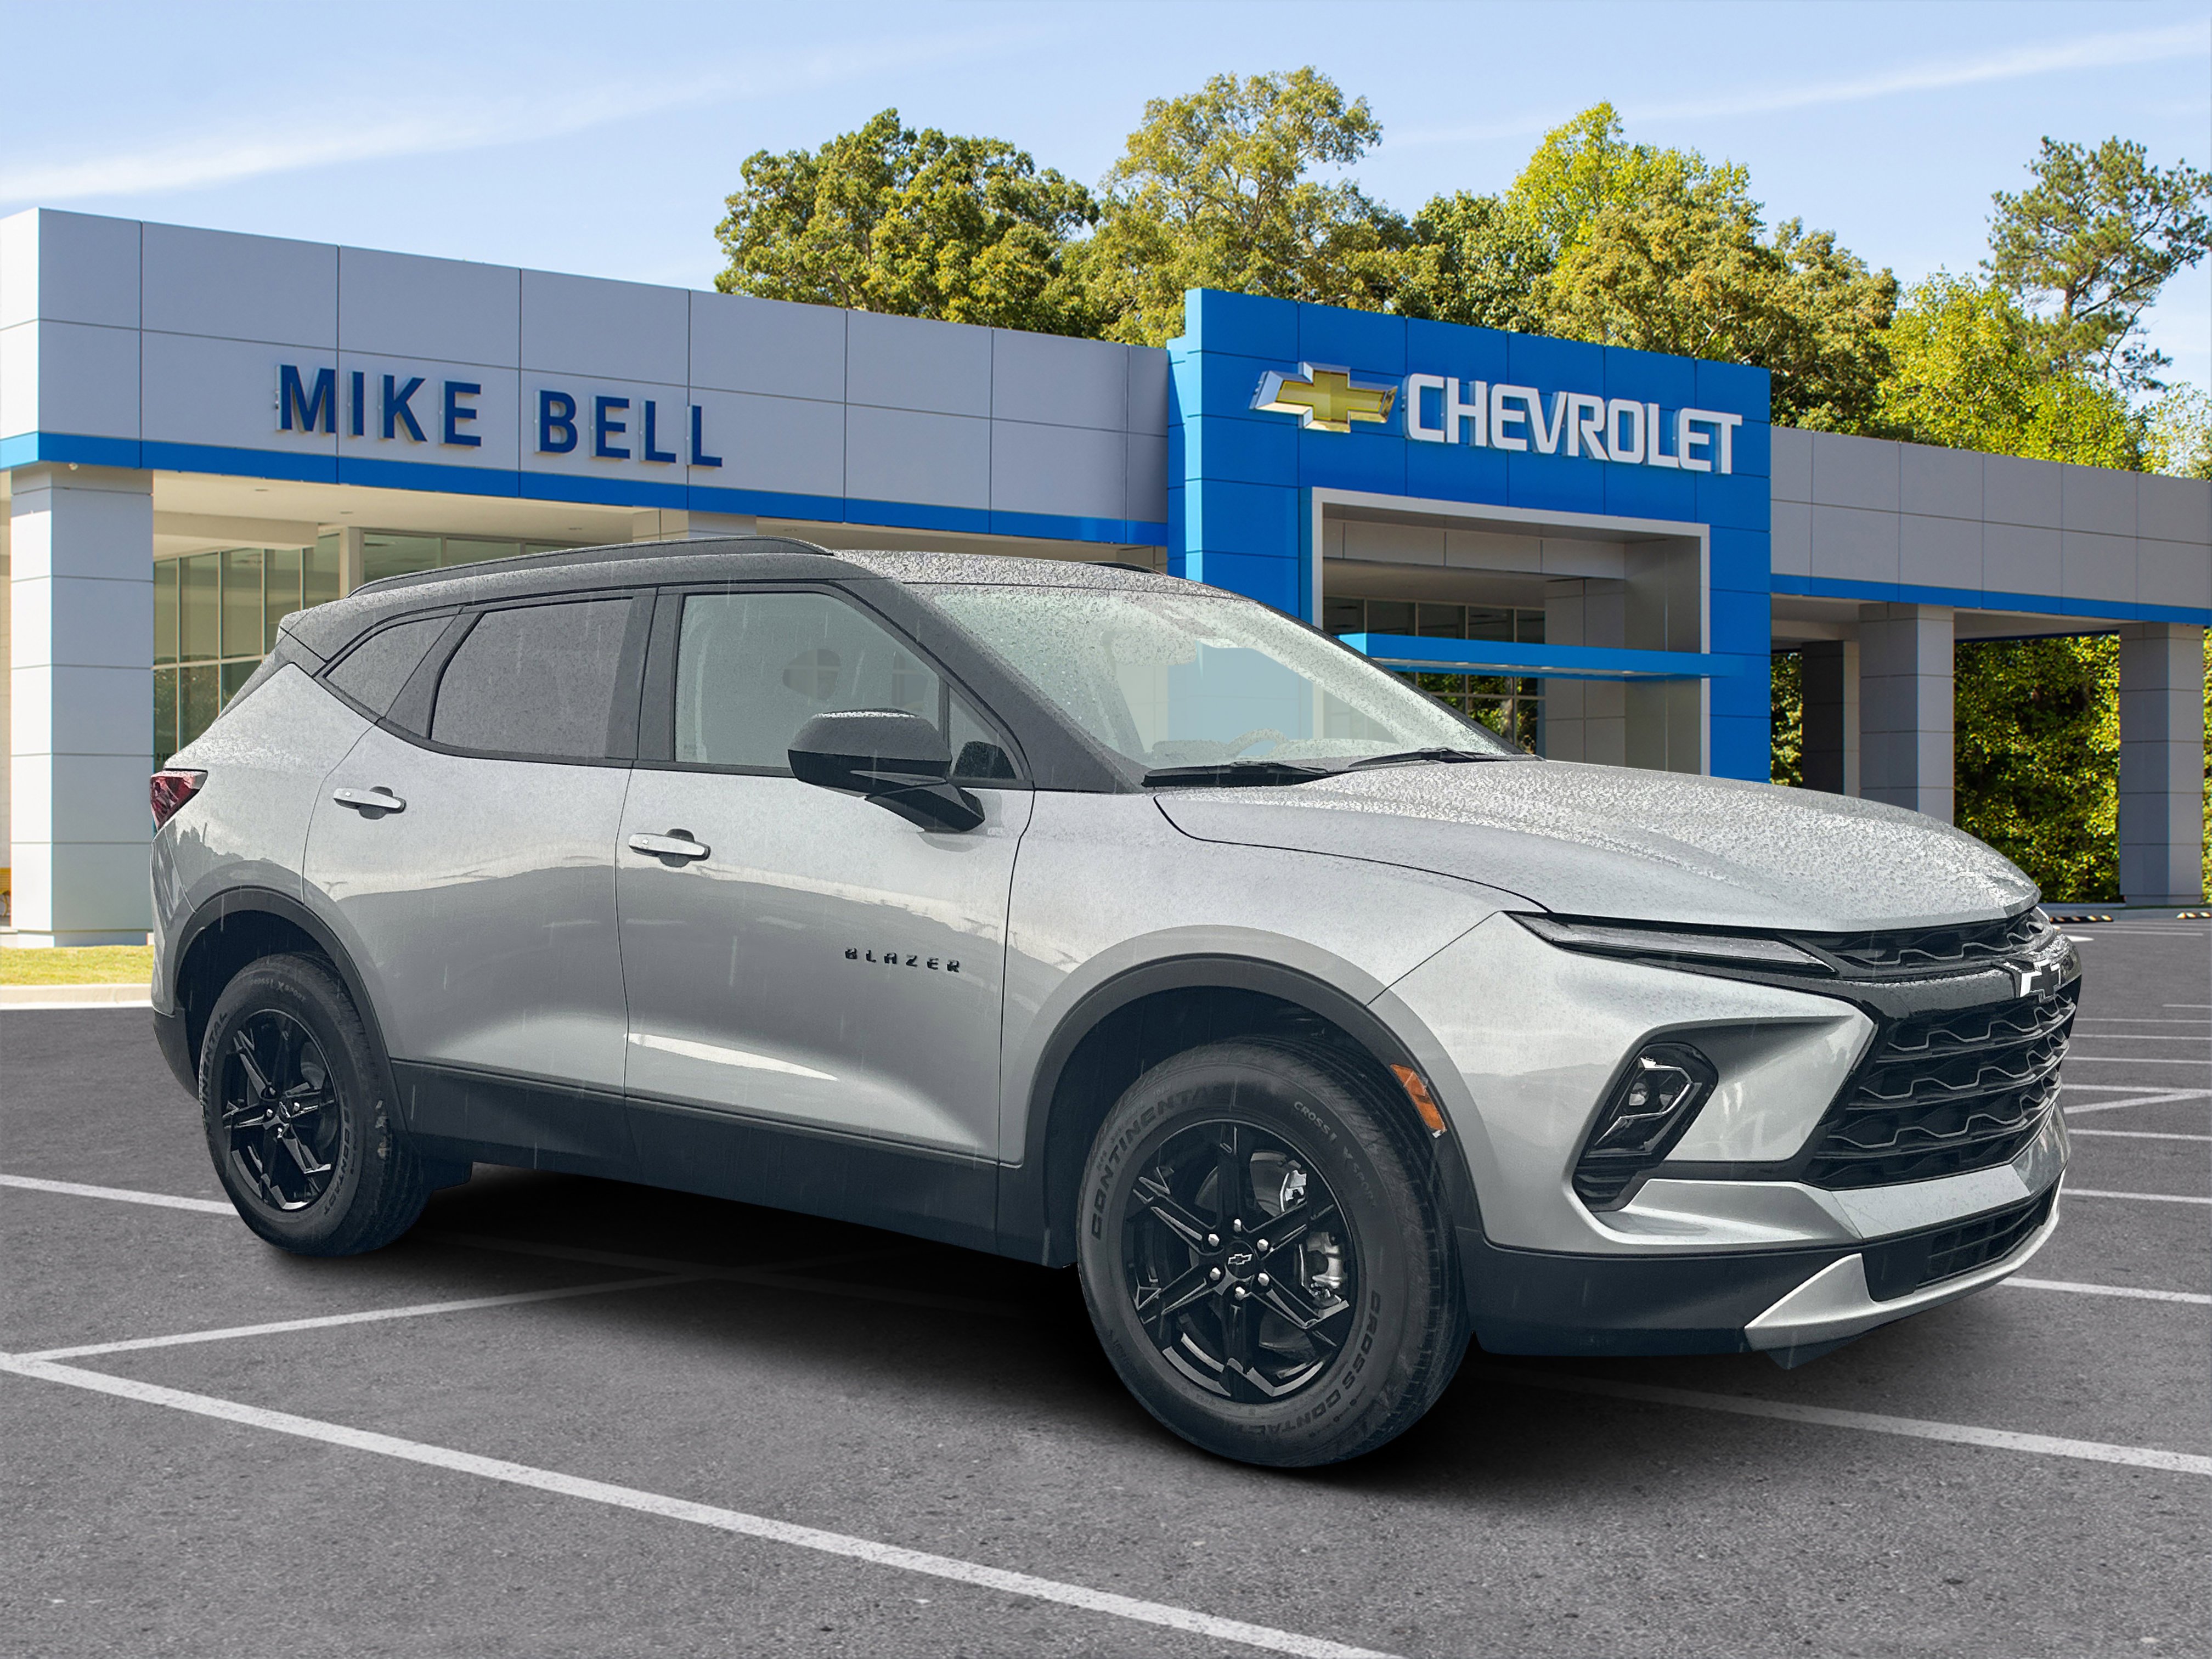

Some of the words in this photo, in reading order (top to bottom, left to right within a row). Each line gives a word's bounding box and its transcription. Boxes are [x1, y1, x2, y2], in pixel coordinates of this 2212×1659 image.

[276, 364, 483, 448] MIKE
[535, 390, 724, 468] BELL
[1403, 373, 1743, 475] CHEVROLET
[845, 947, 960, 973] BLAZER
